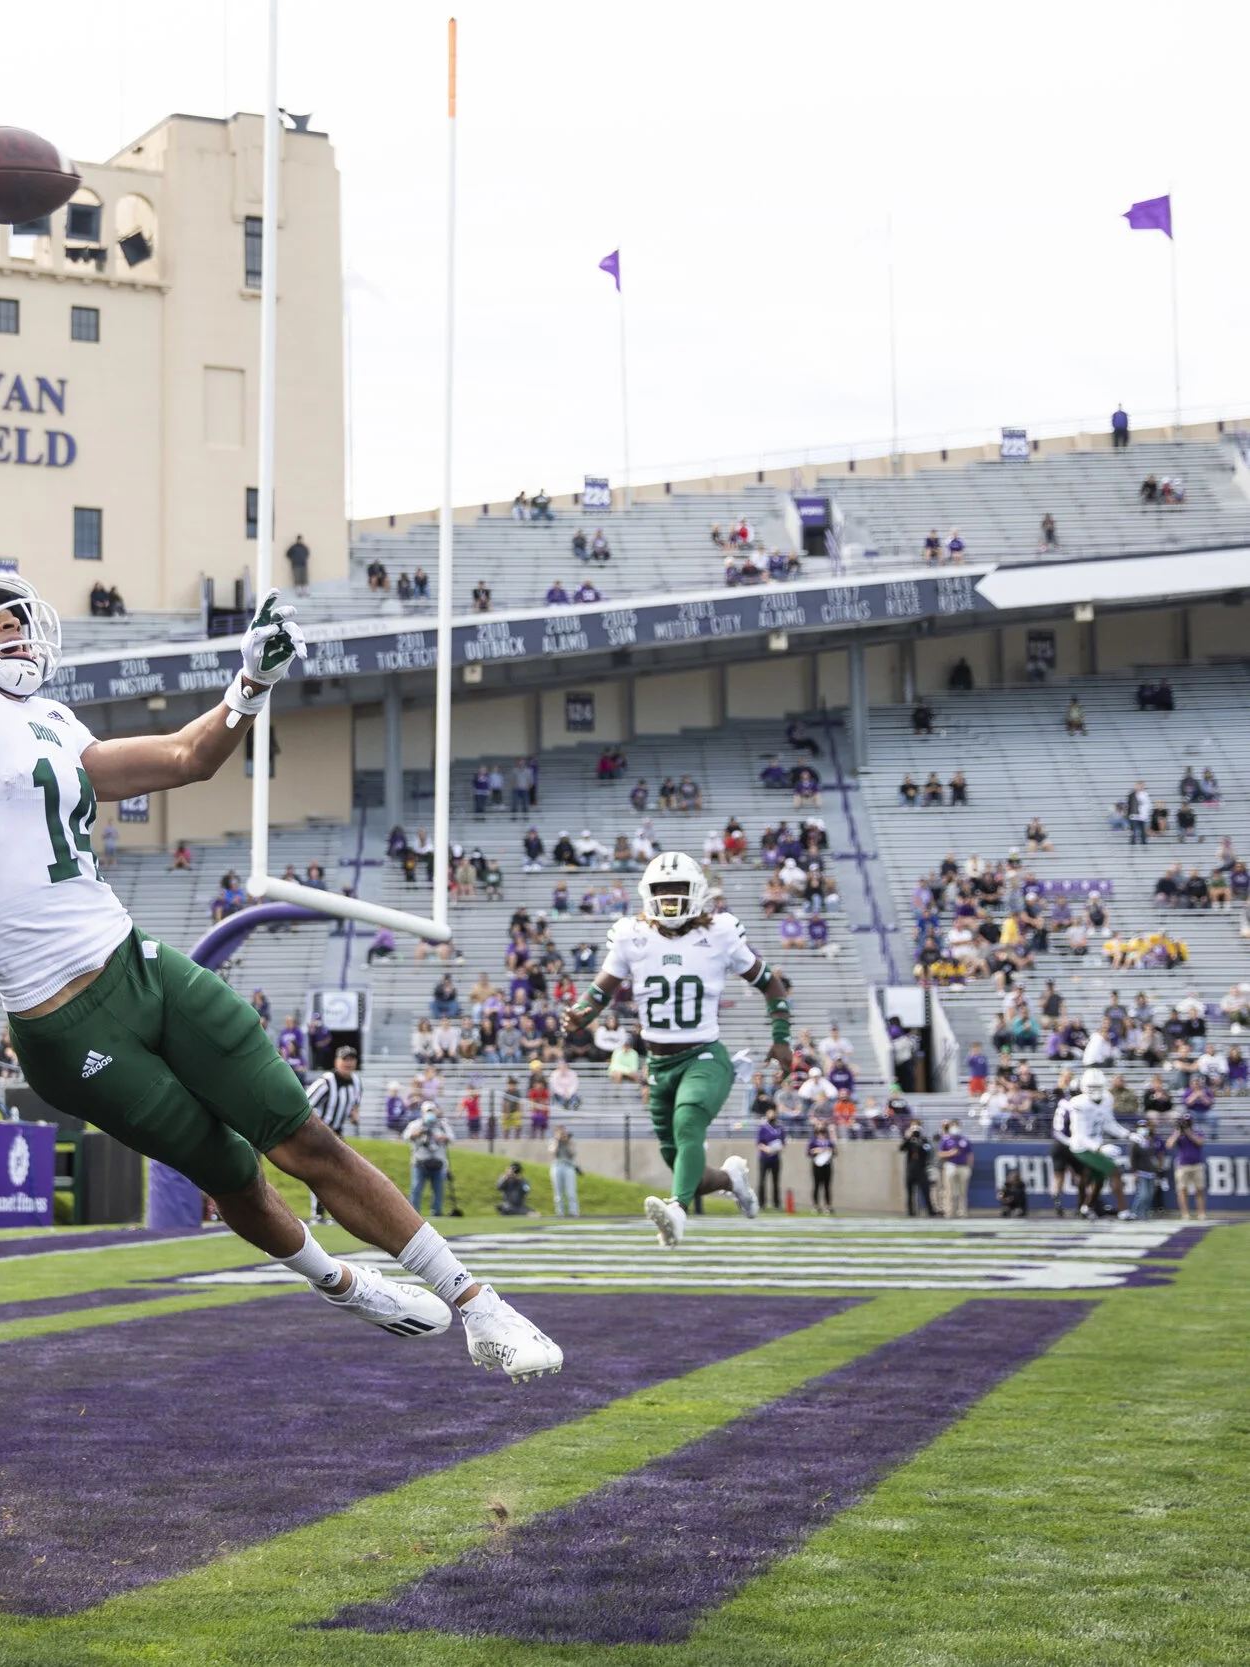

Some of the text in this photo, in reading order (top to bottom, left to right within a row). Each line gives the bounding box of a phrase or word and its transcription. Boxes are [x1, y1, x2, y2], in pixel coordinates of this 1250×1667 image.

[758, 606, 806, 628] ALAMO
[821, 600, 871, 624] CITRUS
[885, 598, 922, 617] ROSE
[608, 626, 637, 646] SUN
[654, 613, 742, 640] MOTOR CITY
[465, 636, 526, 660] OUTBACK
[541, 631, 589, 653] ALAMO
[303, 654, 359, 676] MEINEKE
[109, 673, 166, 697] PINSTRIPE
[178, 667, 234, 690] OUTBACK
[72, 682, 95, 702] CITY
[28, 721, 63, 748] OHIO
[644, 975, 704, 1029] 20
[81, 1055, 113, 1078] adidas
[17, 1191, 48, 1212] fitness
